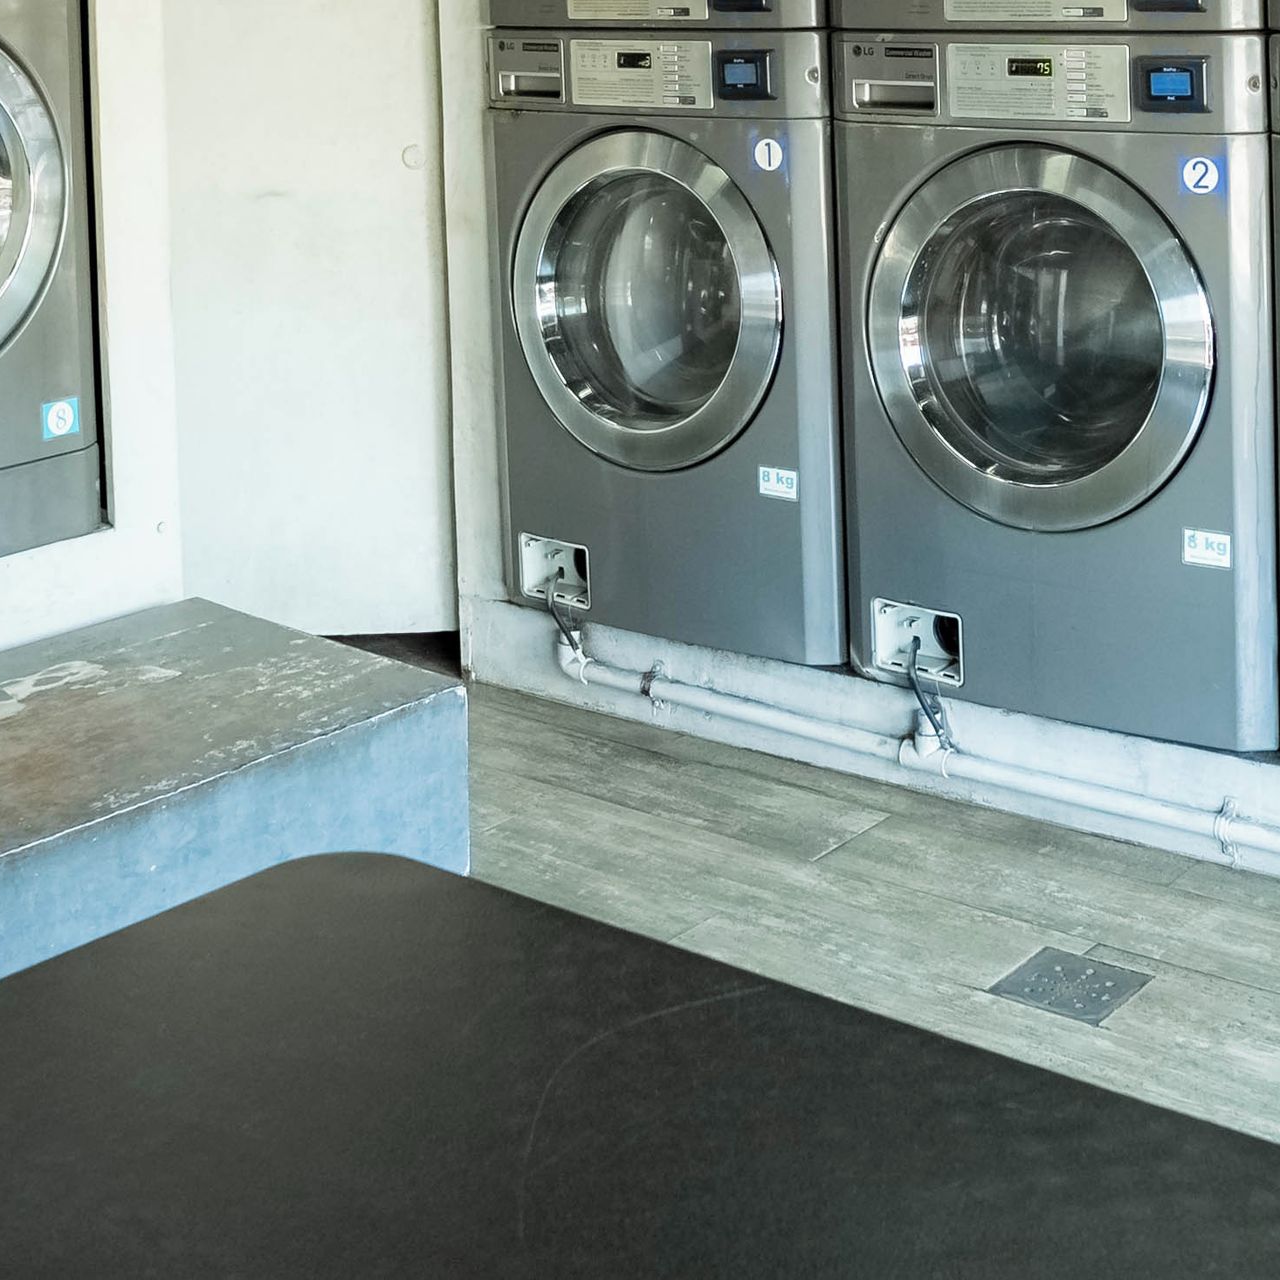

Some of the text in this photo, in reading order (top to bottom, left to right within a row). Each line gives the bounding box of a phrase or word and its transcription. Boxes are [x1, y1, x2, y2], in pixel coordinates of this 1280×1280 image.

[506, 42, 515, 50] LG
[863, 47, 874, 56] LG
[1037, 63, 1050, 74] 75
[1192, 160, 1209, 190] 2
[55, 408, 67, 430] 8
[762, 470, 794, 489] 8 kg
[1204, 537, 1227, 556] kg
